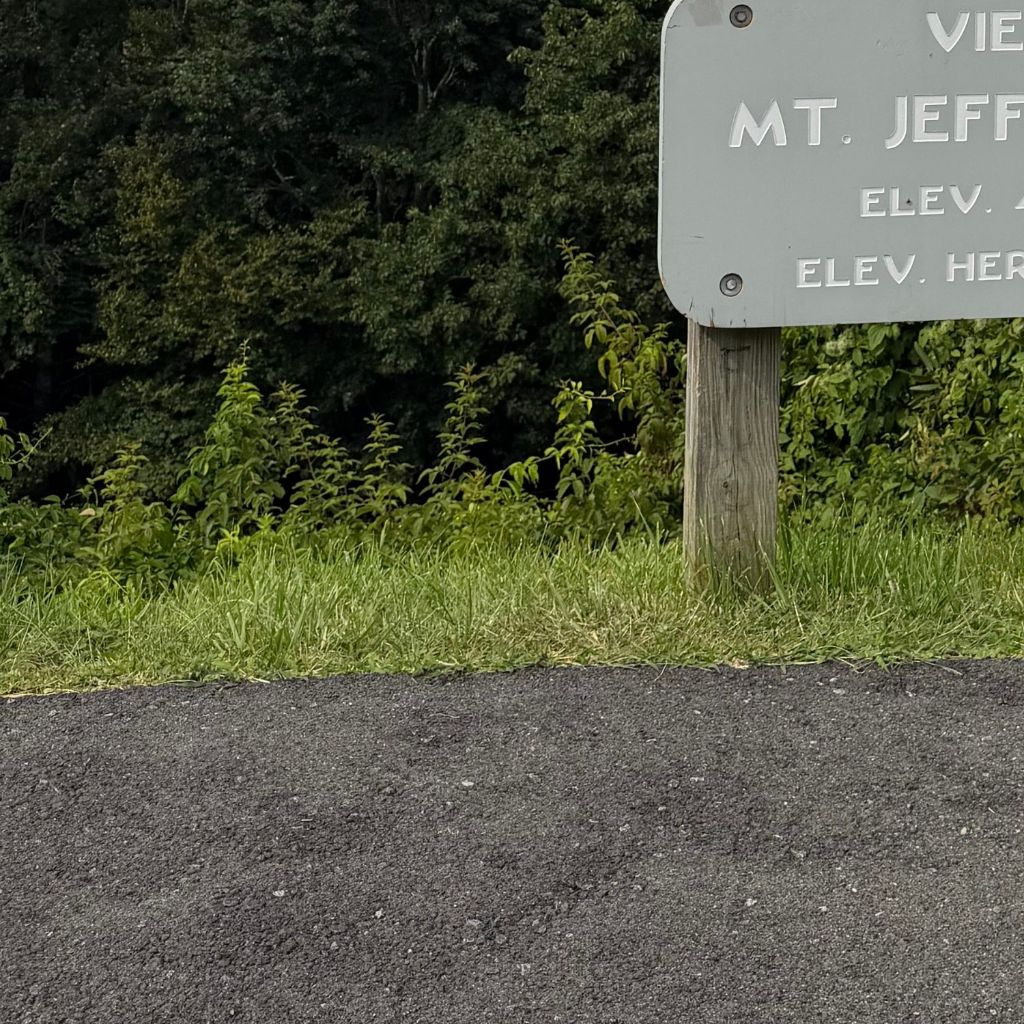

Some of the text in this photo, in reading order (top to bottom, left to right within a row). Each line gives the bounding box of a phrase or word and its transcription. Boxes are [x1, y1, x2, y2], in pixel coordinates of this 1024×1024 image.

[727, 97, 852, 148] MT.
[859, 183, 993, 218] ELEV.
[795, 253, 926, 289] ELEV.
